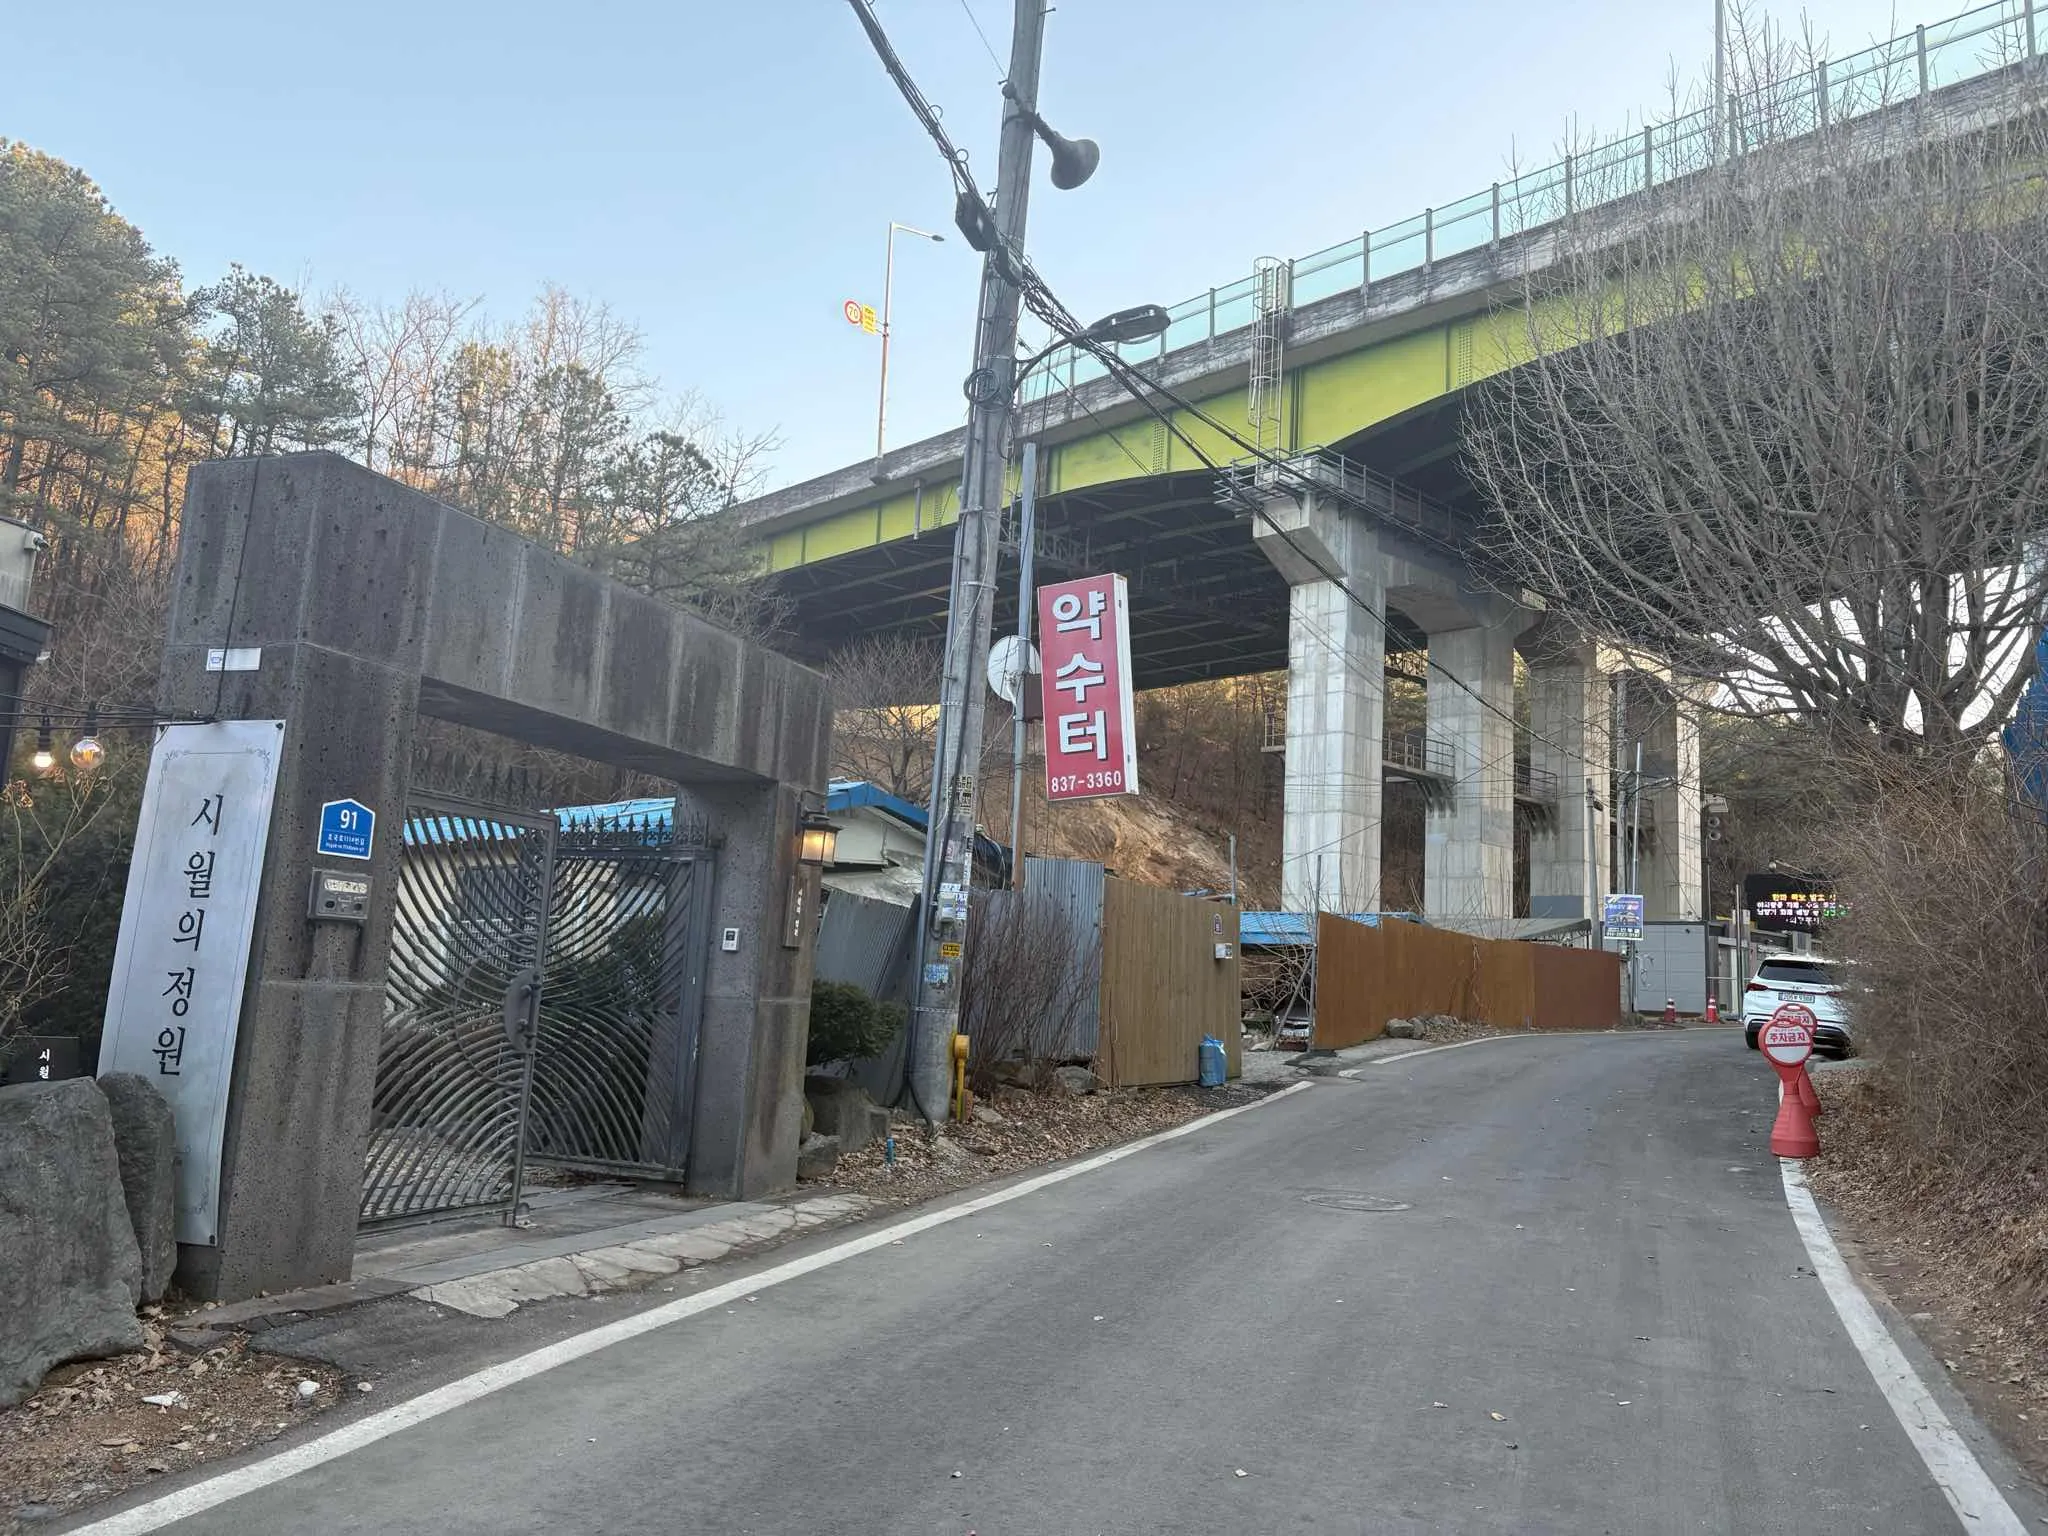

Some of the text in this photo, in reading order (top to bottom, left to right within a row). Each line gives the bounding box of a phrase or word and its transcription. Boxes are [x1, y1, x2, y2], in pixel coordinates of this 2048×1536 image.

[1052, 589, 1107, 761] 약수터
[1051, 771, 1122, 792] 837-3360
[340, 809, 357, 830] 91
[1770, 1032, 1806, 1042] 주차금지
